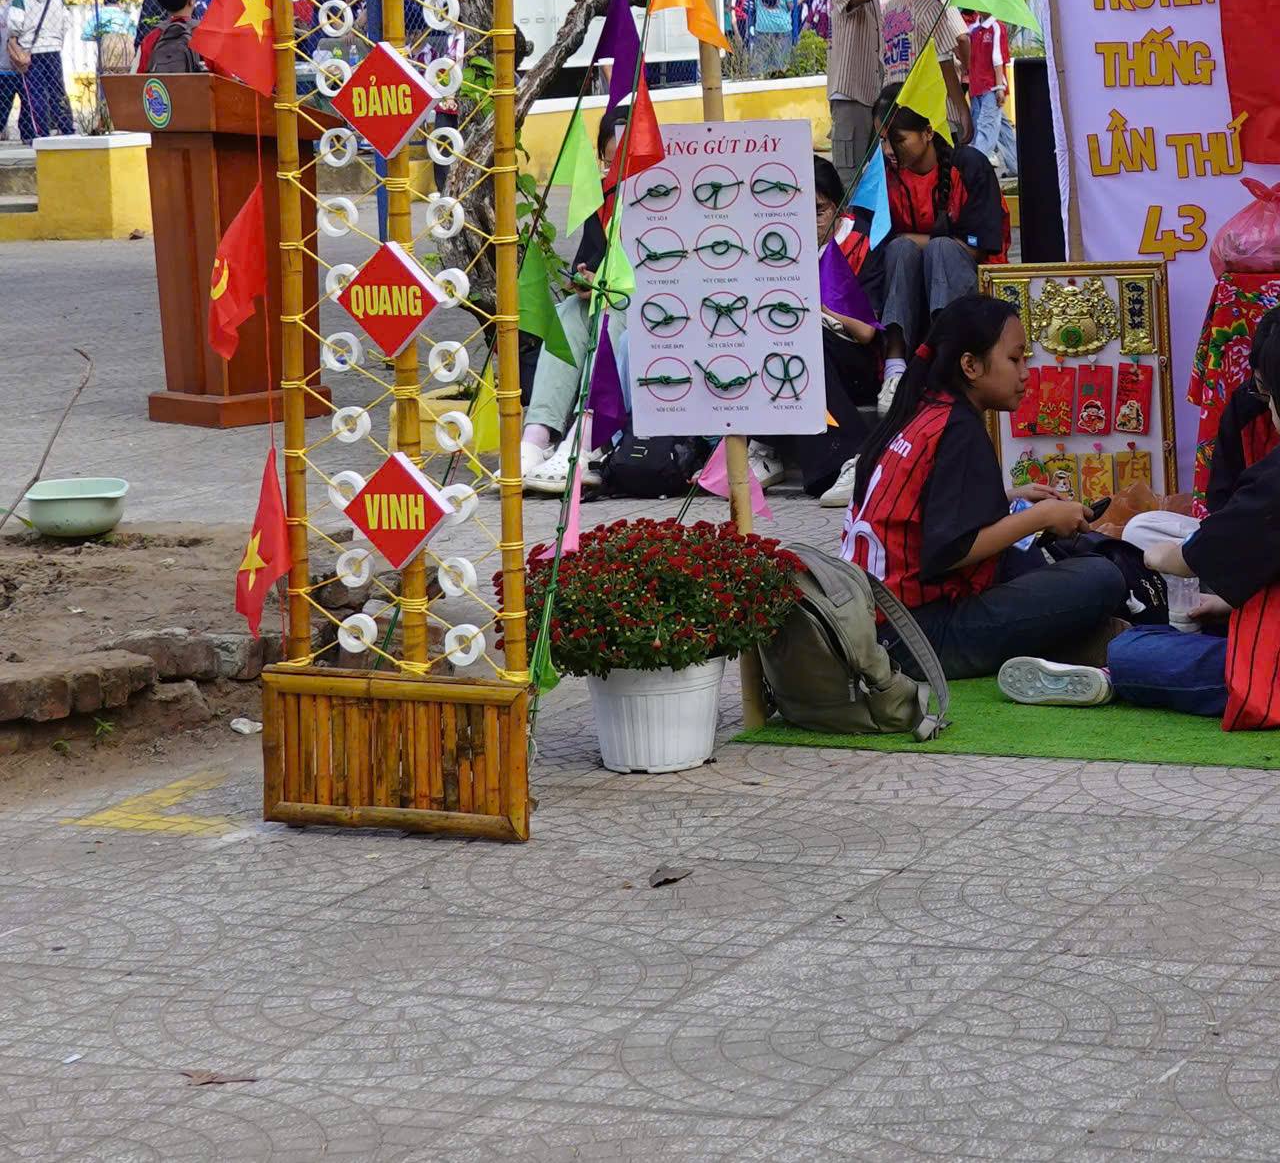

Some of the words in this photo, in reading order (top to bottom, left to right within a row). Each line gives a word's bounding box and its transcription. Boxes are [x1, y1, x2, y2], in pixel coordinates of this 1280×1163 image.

[1095, 26, 1215, 87] THỐNG
[352, 76, 412, 117] ĐẢNG
[704, 136, 740, 155] GÚT
[745, 134, 781, 153] DÂY
[1087, 108, 1157, 177] LẦN
[1166, 111, 1249, 178] THỨ
[1138, 204, 1208, 261] 43
[351, 284, 422, 319] QUANG
[364, 494, 425, 530] VINH
